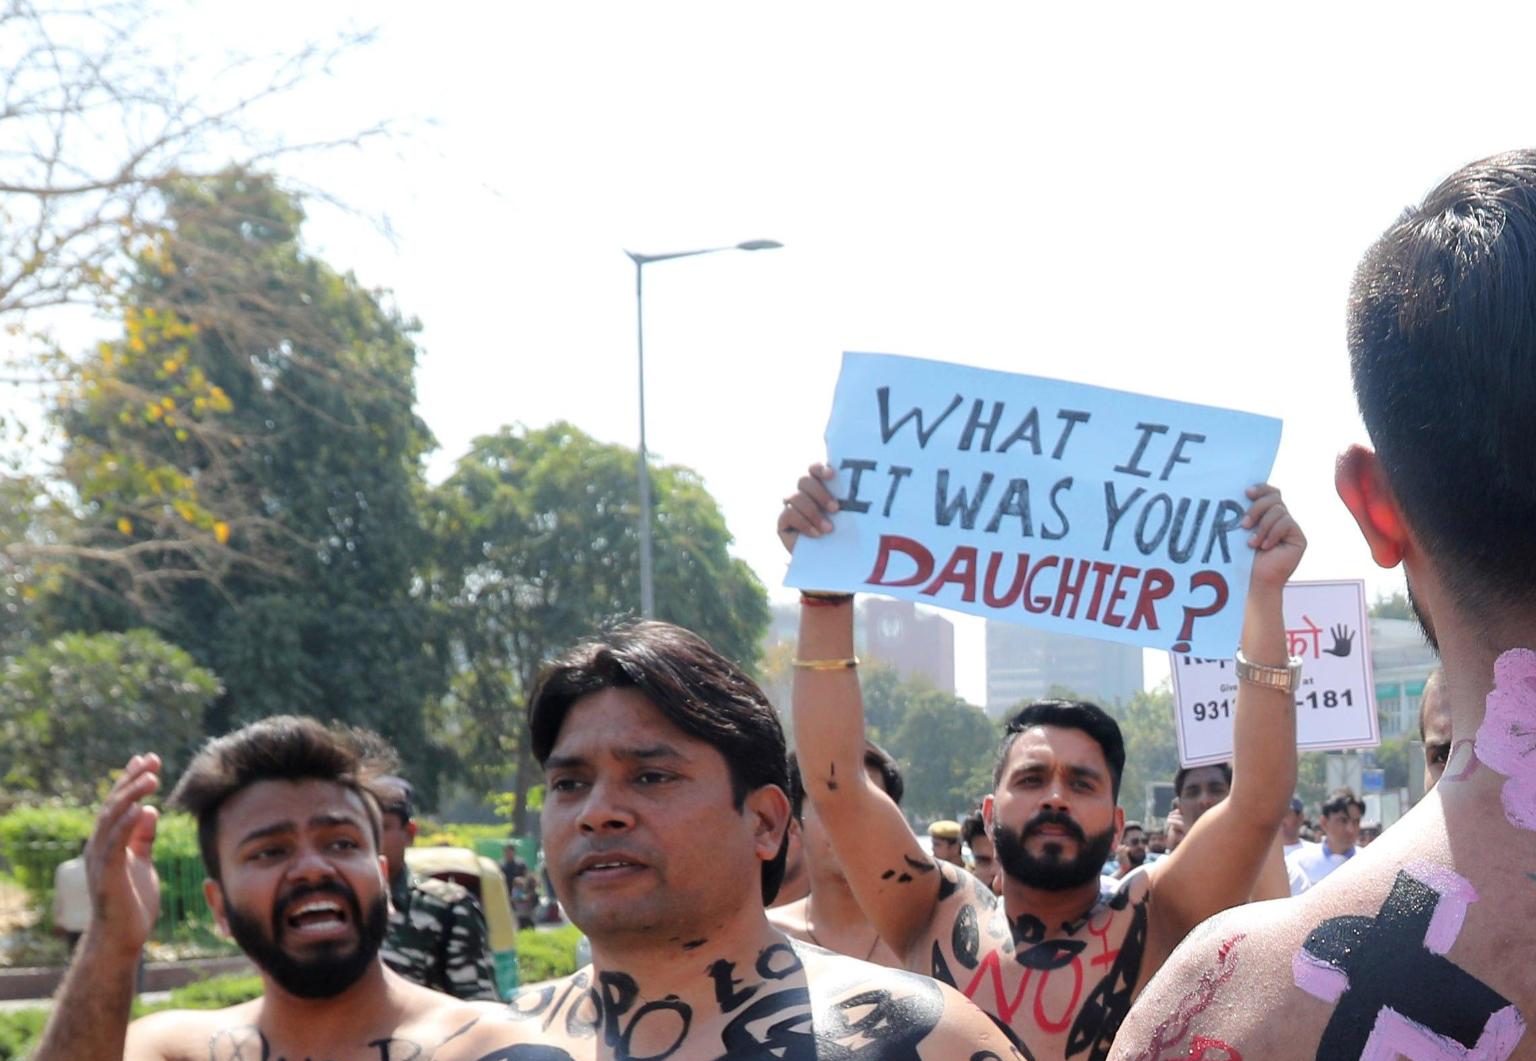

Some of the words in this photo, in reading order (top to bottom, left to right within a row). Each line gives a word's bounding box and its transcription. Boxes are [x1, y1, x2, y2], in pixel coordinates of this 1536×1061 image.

[876, 385, 1092, 460] WHAT
[1113, 420, 1207, 482] IF
[837, 457, 913, 518] IT
[935, 468, 1074, 541] WAS
[1102, 480, 1247, 564] YOUR
[863, 533, 1230, 653] DAUGHTER?
[1192, 698, 1237, 722] 931
